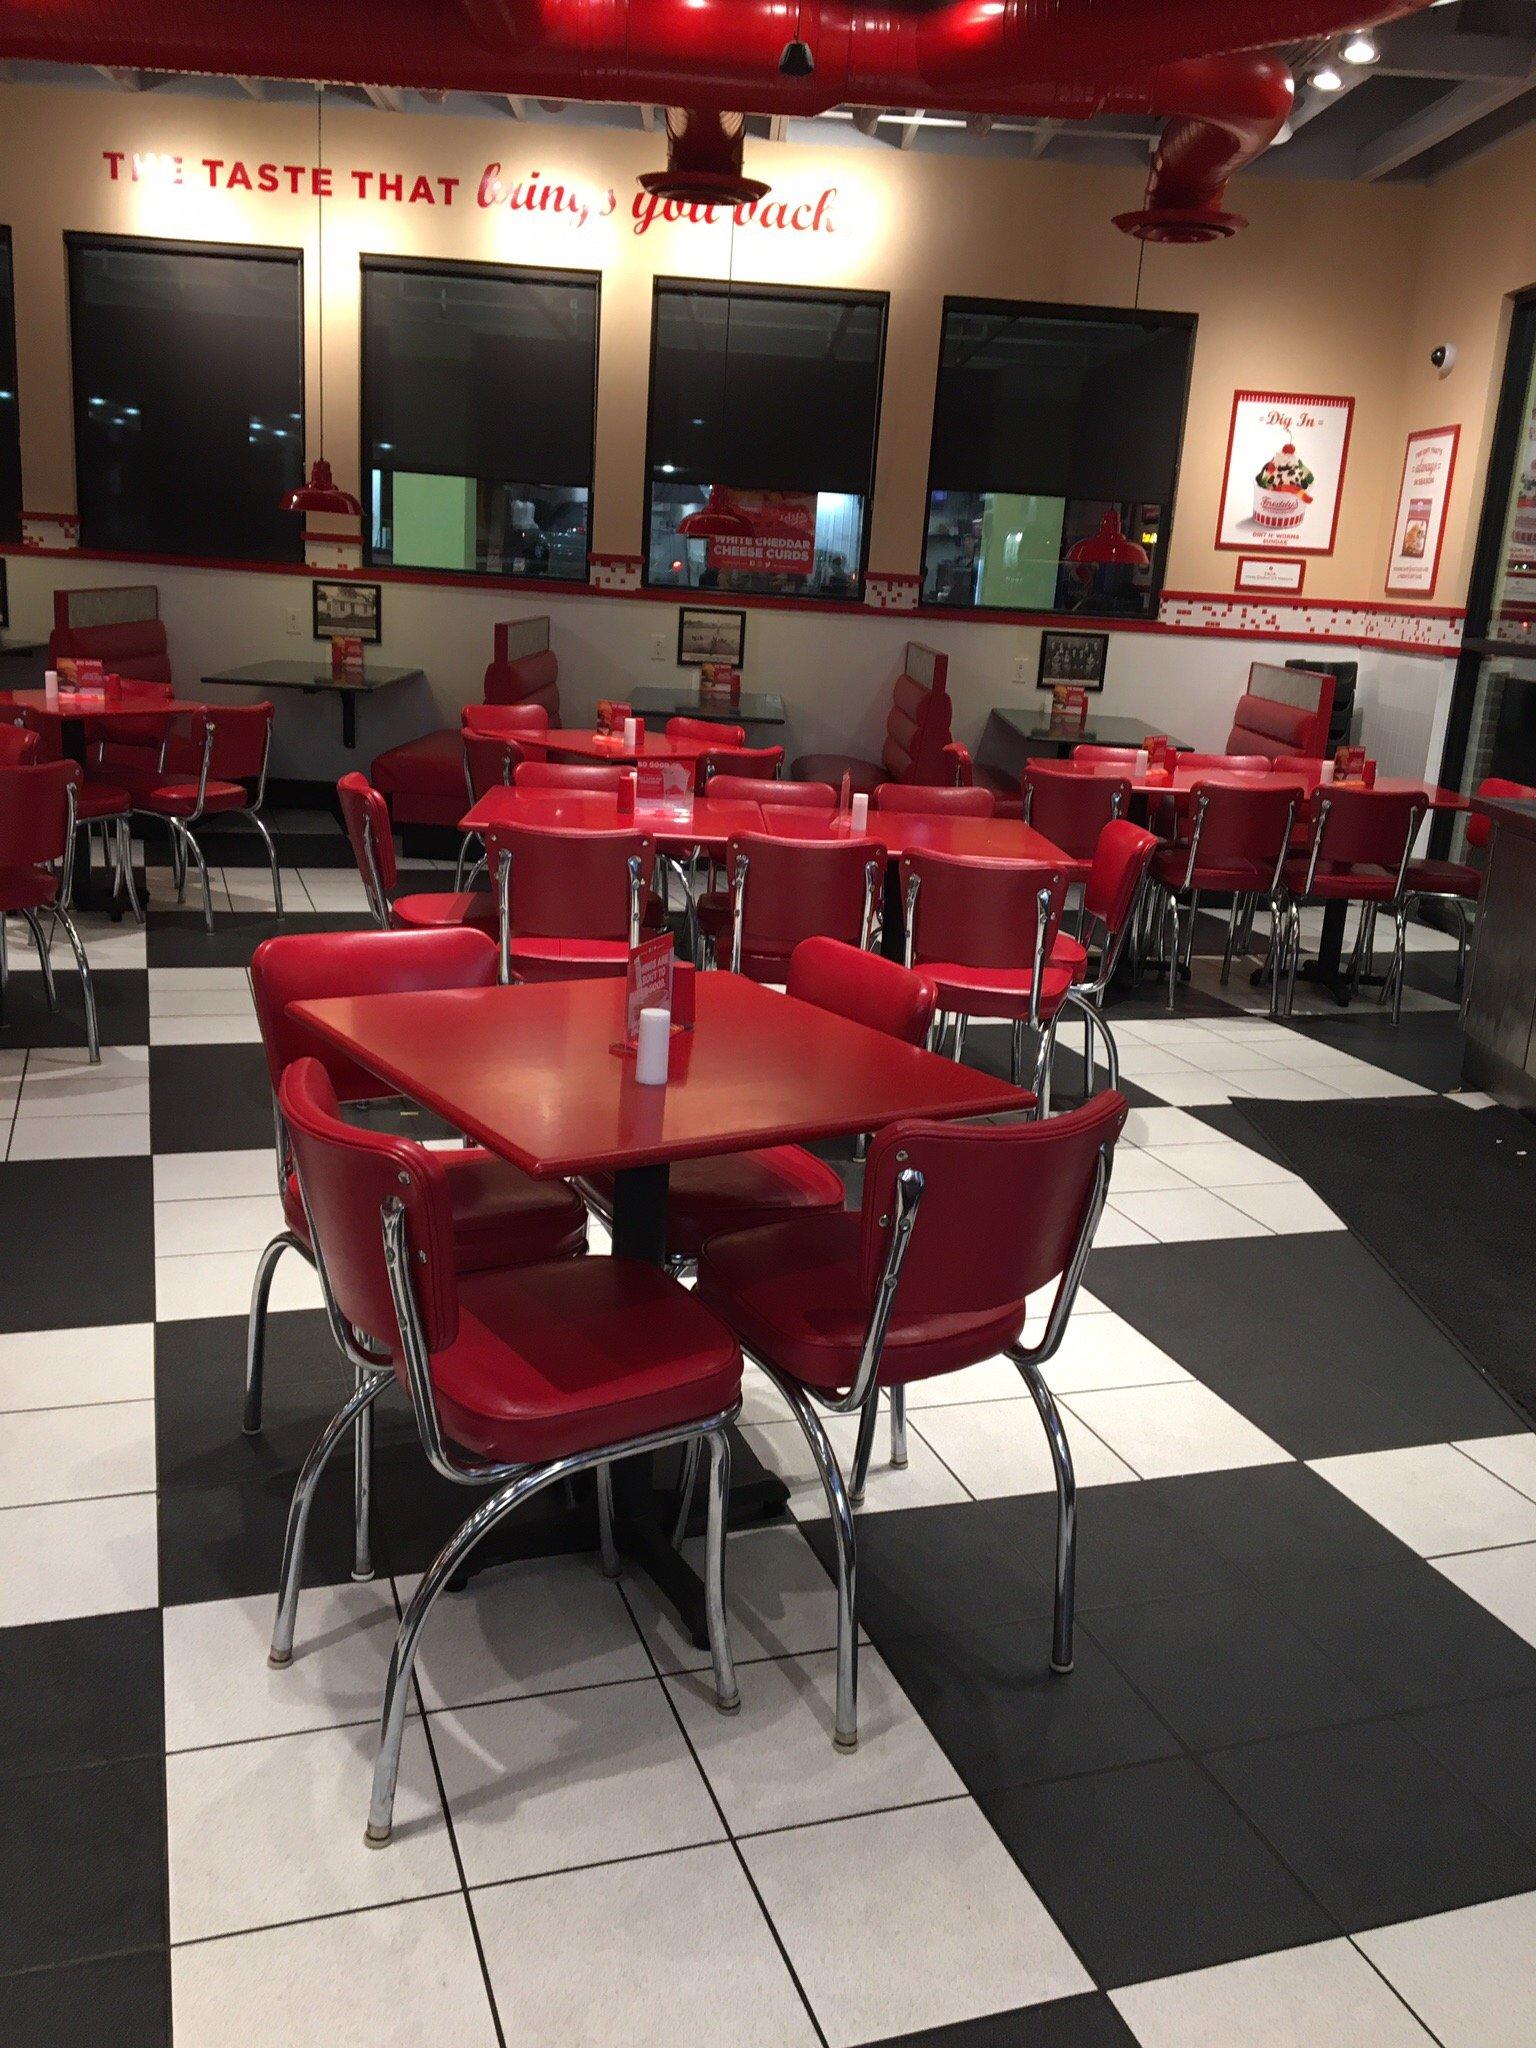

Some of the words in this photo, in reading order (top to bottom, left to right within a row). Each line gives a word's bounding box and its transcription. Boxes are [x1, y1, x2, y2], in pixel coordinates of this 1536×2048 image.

[202, 159, 333, 196] TASTE
[351, 171, 460, 206] THAT
[1266, 410, 1292, 431] Dig
[1296, 412, 1315, 427] In
[715, 534, 753, 546] WHITE
[755, 536, 811, 550] CHEDDAR
[713, 544, 763, 559] CHEESE
[766, 548, 809, 562] CURDS
